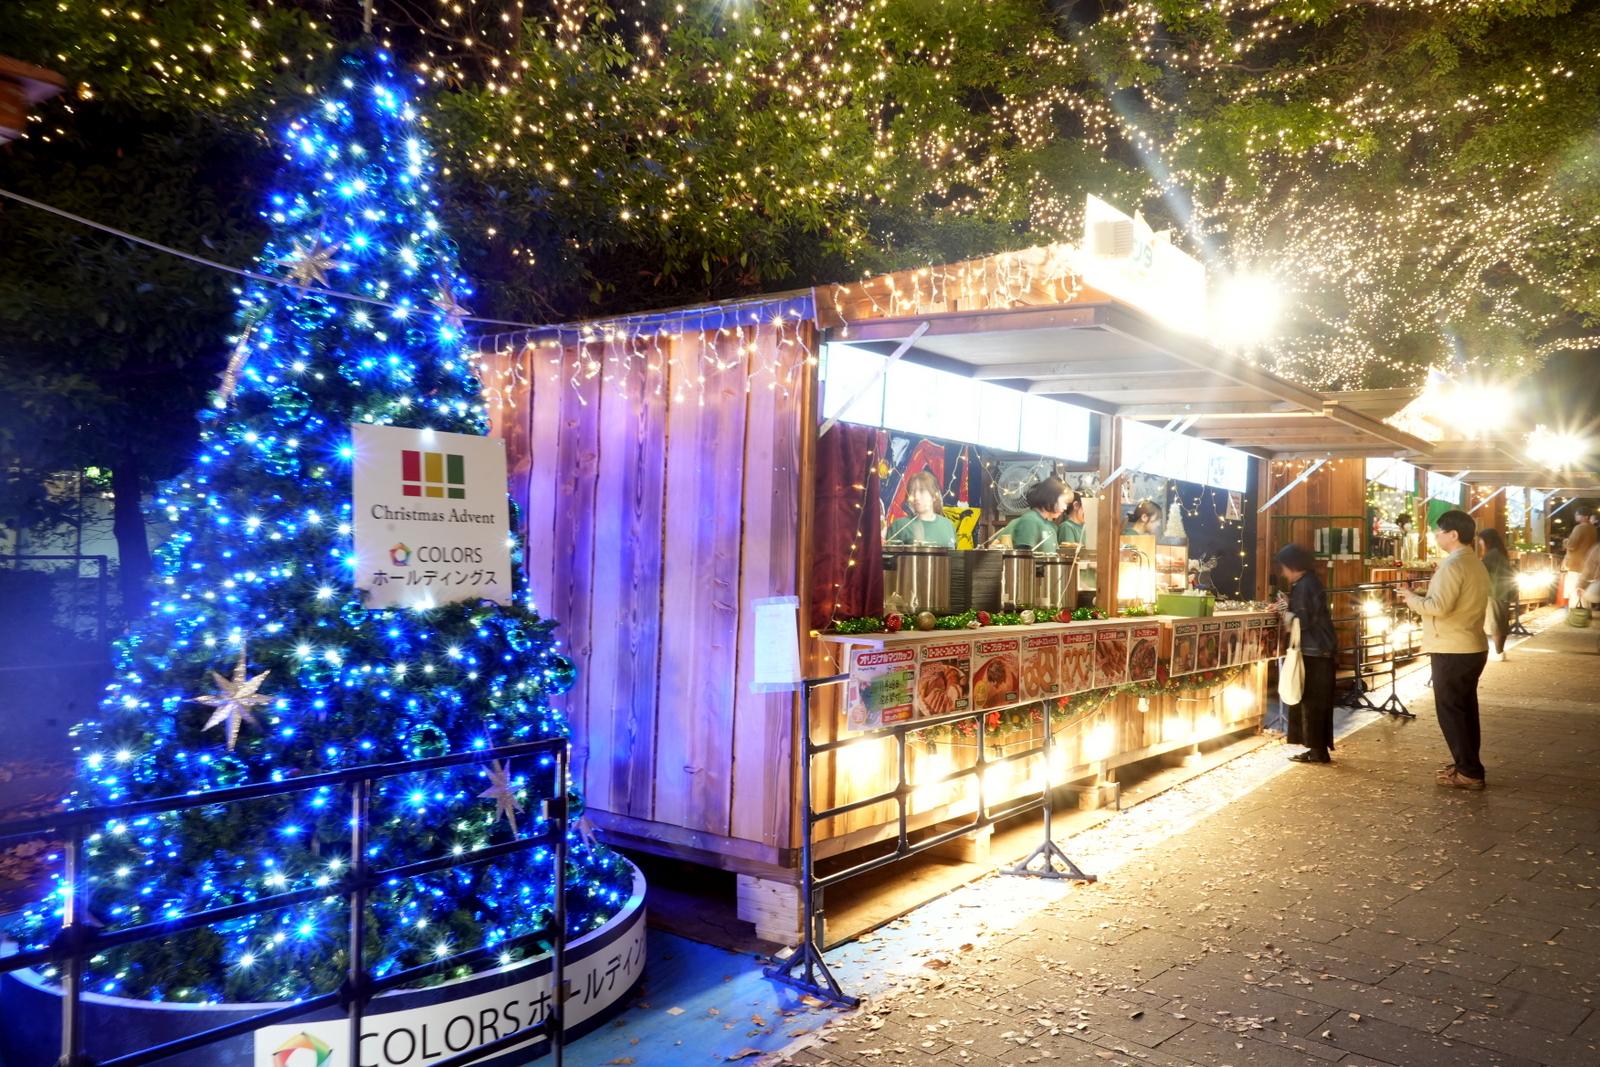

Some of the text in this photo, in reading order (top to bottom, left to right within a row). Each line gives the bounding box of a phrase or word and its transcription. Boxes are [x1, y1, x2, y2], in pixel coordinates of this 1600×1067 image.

[371, 504, 496, 524] Christmas Advent
[417, 546, 483, 563] COLORS
[372, 569, 498, 587] ホールディングス
